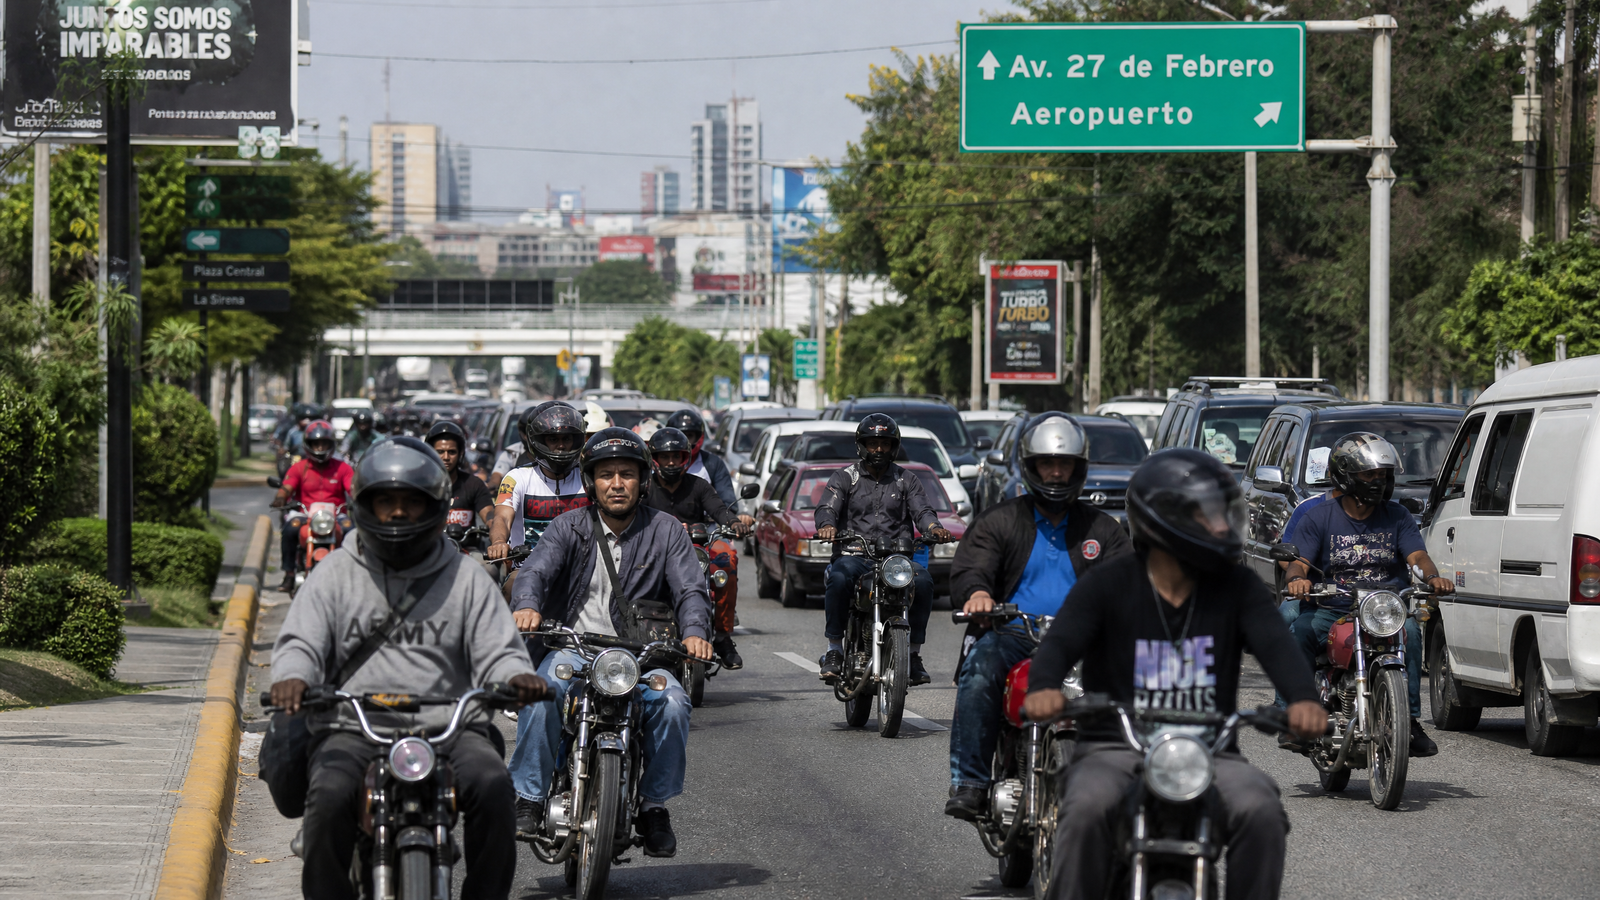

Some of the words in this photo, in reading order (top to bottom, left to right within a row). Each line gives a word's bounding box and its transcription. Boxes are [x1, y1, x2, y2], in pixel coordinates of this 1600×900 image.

[153, 6, 232, 30] SOMOS
[59, 31, 232, 60] IMPARABLES
[1008, 54, 1053, 78] Av.
[1066, 54, 1106, 78] 27
[1119, 54, 1152, 78] de
[1166, 53, 1274, 78] Febrero
[1010, 101, 1193, 131] Aeropuerto
[193, 265, 223, 277] Plaza
[225, 265, 265, 277] Central
[193, 293, 208, 305] La
[210, 293, 245, 305] Sirena
[998, 306, 1050, 322] TURBO
[1133, 635, 1217, 690] NICE
